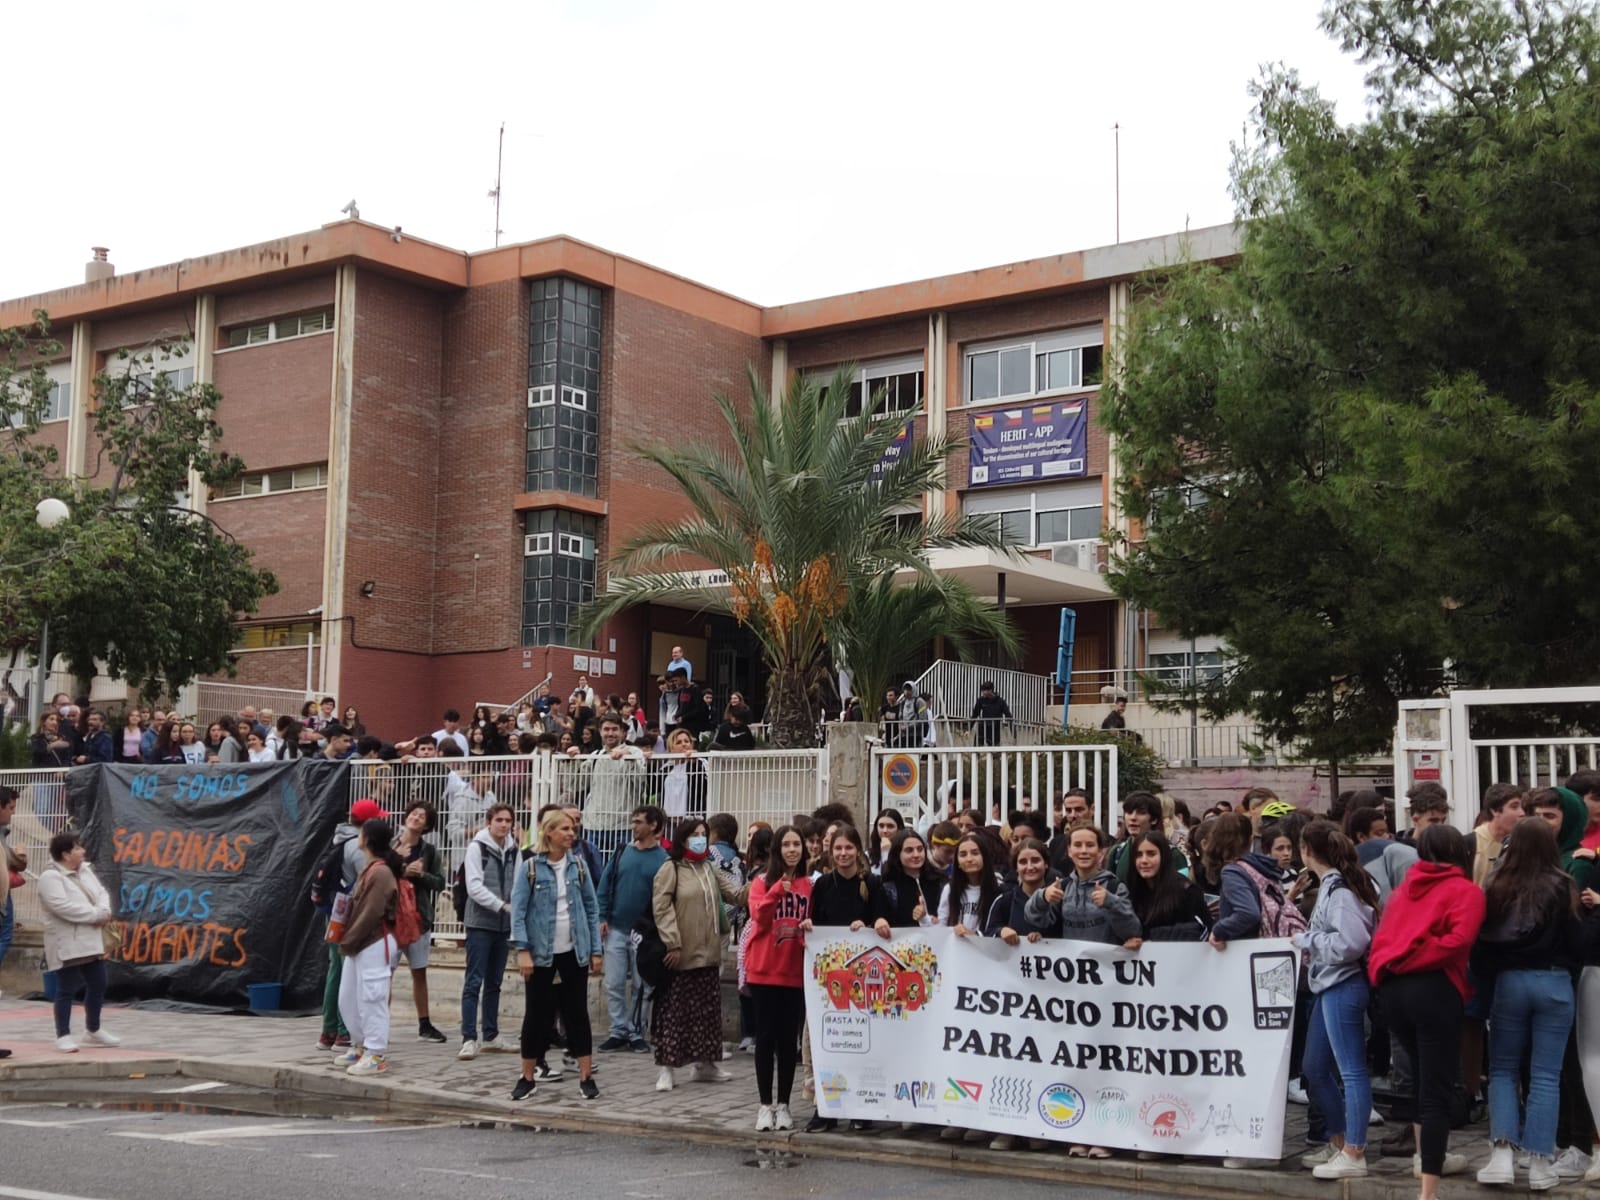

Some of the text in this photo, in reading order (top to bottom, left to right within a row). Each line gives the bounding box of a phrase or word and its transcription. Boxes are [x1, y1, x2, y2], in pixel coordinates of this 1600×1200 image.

[1000, 427, 1028, 443] HERIT
[1035, 425, 1054, 439] APP
[130, 773, 250, 800] NO SOMOS
[112, 827, 251, 872] SARDINAS
[119, 883, 214, 918] SOMOS
[1020, 955, 1157, 987] #POR UN
[954, 986, 1229, 1032] ESPACIO DIGNO
[943, 1026, 1247, 1077] PARA APRENDER
[1101, 1090, 1126, 1102] AMPA
[1152, 1127, 1182, 1140] AMPA
